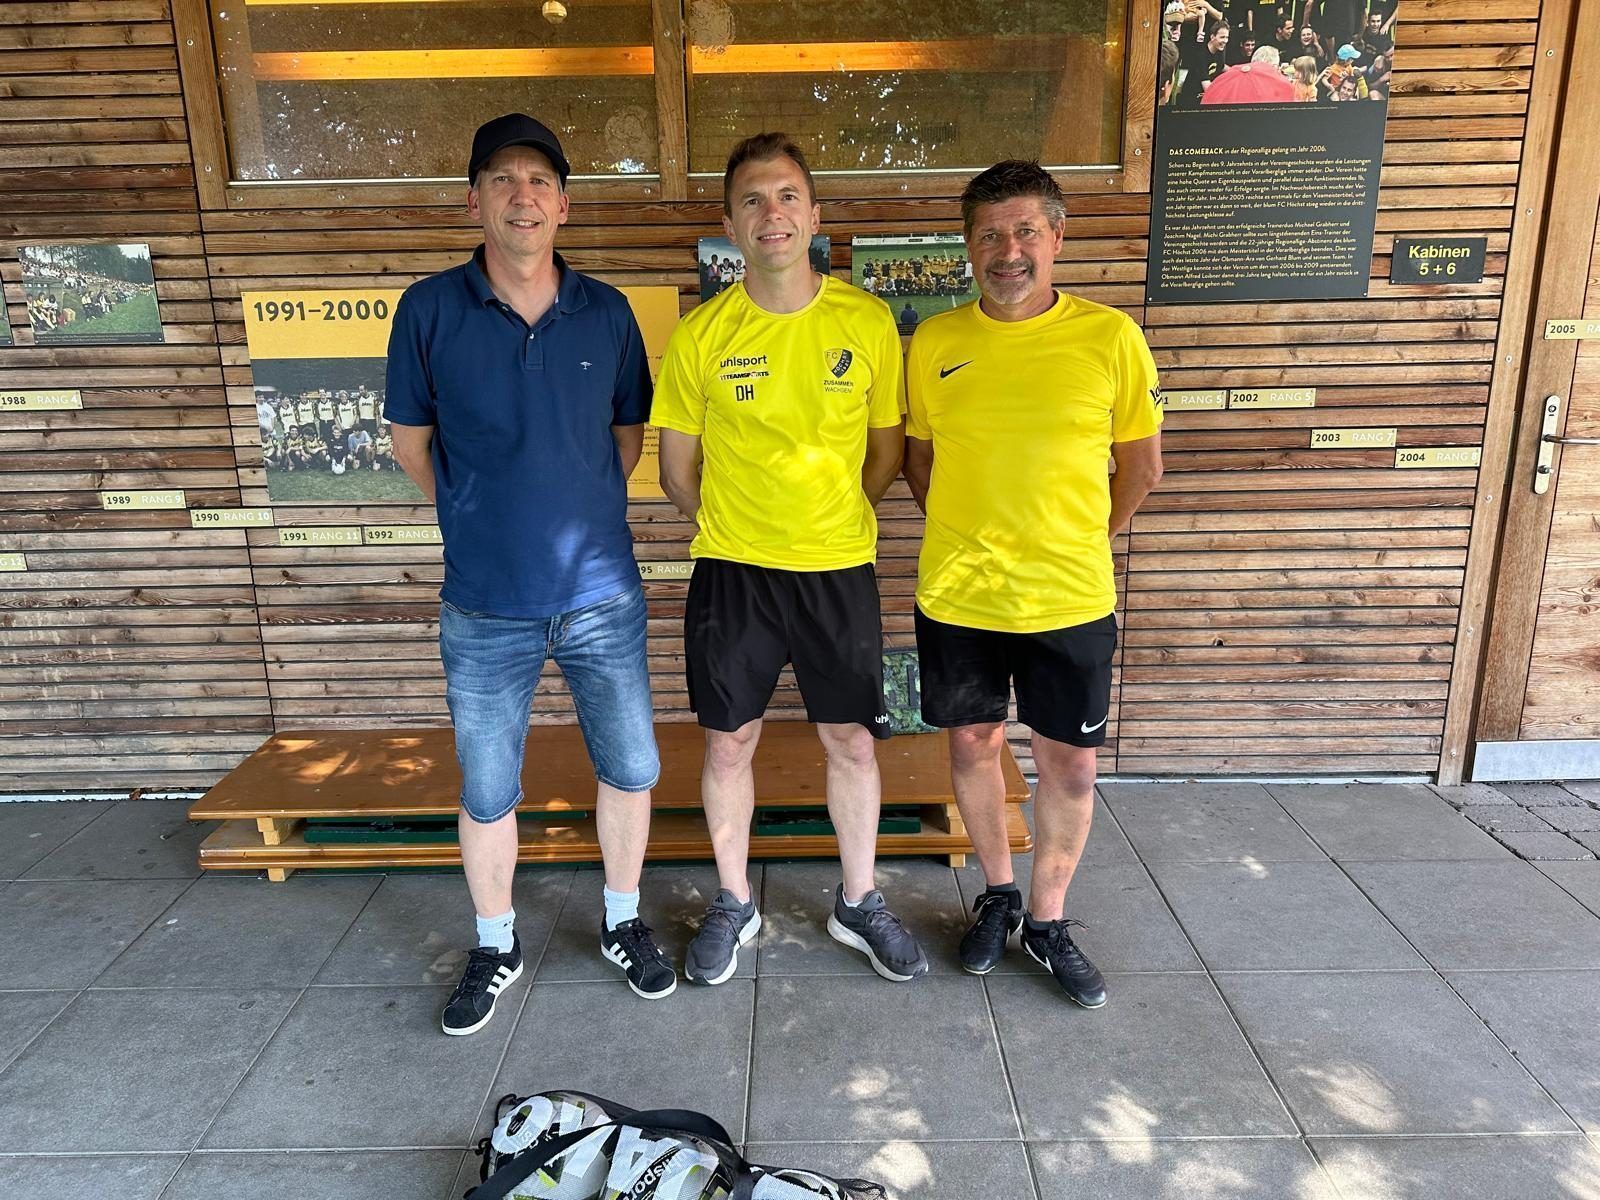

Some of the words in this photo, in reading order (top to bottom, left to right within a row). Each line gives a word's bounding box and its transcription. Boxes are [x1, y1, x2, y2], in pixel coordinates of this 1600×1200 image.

[1409, 245, 1470, 258] Kabinen
[1419, 262, 1429, 275] 5
[1433, 264, 1442, 274] +
[1446, 262, 1456, 275] 6
[1550, 325, 1576, 333] 2005
[720, 355, 768, 368] uhlsport
[736, 384, 754, 401] DH
[1233, 394, 1258, 402] 2002
[1270, 393, 1302, 401] RANG
[1305, 392, 1311, 401] 5
[2, 396, 26, 405] 1988
[37, 396, 68, 404] RANG
[1181, 396, 1213, 404] RANG
[1216, 395, 1222, 404] 5
[1316, 434, 1340, 442] 2003
[1352, 433, 1383, 441] RANG
[1387, 432, 1394, 441] 7
[1400, 453, 1425, 462] 2004
[1436, 452, 1468, 461] RANG
[1471, 452, 1478, 460] 8
[107, 496, 131, 504] 1989
[142, 496, 172, 504] RANG
[195, 513, 219, 521] 1990
[398, 530, 429, 538] RANG
[657, 565, 687, 573] RANG
